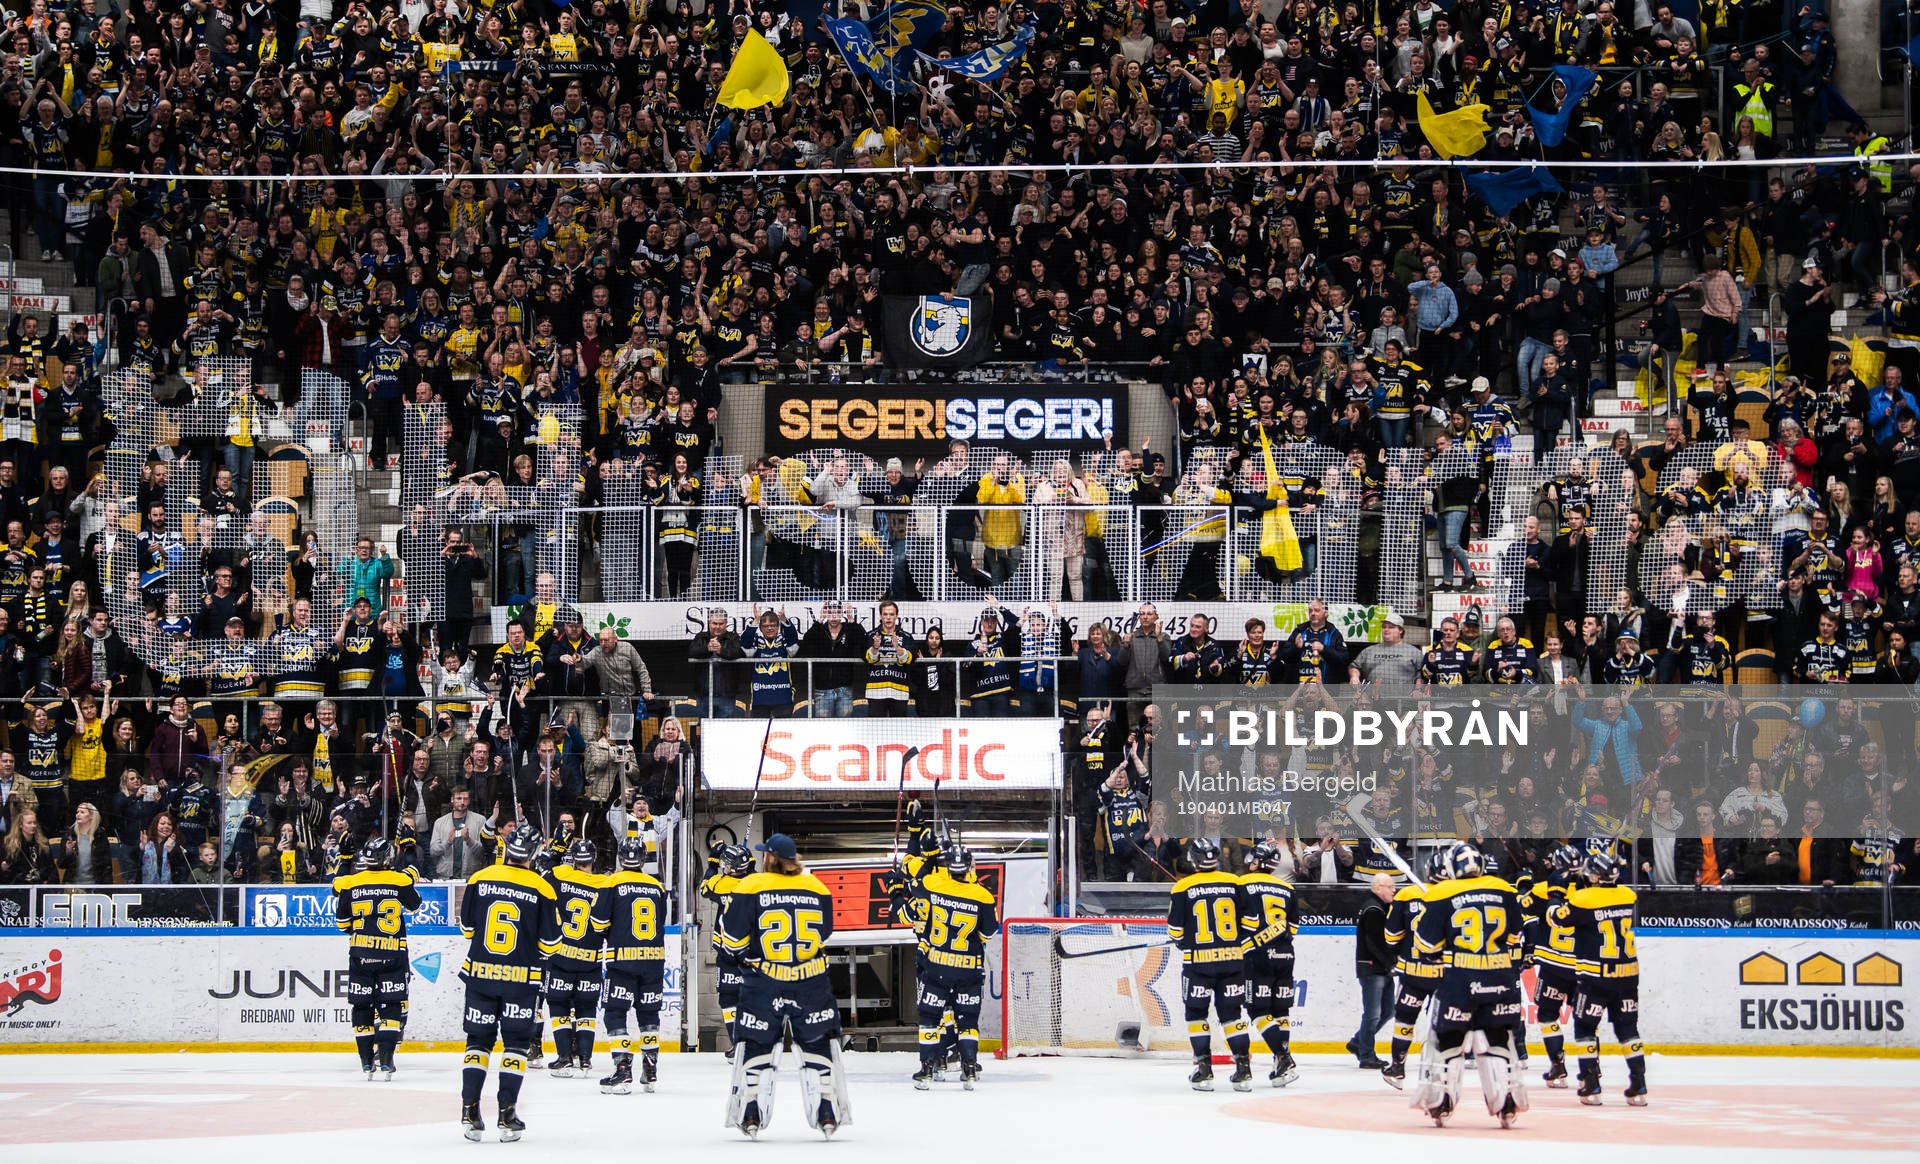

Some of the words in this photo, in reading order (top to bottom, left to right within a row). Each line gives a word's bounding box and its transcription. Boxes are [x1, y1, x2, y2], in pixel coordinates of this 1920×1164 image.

[760, 727, 1006, 782] Scandic
[358, 887, 399, 897] Husqvarna
[487, 884, 538, 904] Husqvarna
[566, 884, 599, 898] Husqva
[770, 893, 819, 906] Husqvarna
[937, 896, 979, 913] Husqvarna
[350, 897, 402, 935] 73
[561, 897, 592, 940] 3
[632, 897, 656, 941] 8
[1192, 897, 1239, 945] 18
[1641, 916, 1731, 929] KONRADSSONS
[1755, 917, 1848, 930] KONRADSSONS
[484, 900, 521, 955] 6
[758, 908, 823, 963] 25
[928, 904, 979, 952] 67
[1450, 905, 1508, 954] 37
[617, 946, 665, 962] ANDERSSO
[470, 961, 529, 983] PERSSON
[380, 980, 405, 993] JP.se
[550, 978, 574, 991] JP.se
[577, 980, 600, 992] JP.se
[240, 1008, 295, 1024] BREDBAND
[303, 1008, 326, 1024] WIFI
[334, 1008, 351, 1024] TEL
[466, 1006, 496, 1024] JP.se
[502, 1003, 533, 1019] JP.se
[1740, 992, 1905, 1032] EKSJÖHUS
[8, 1021, 34, 1029] MUSIC
[36, 1020, 55, 1029] ONLY
